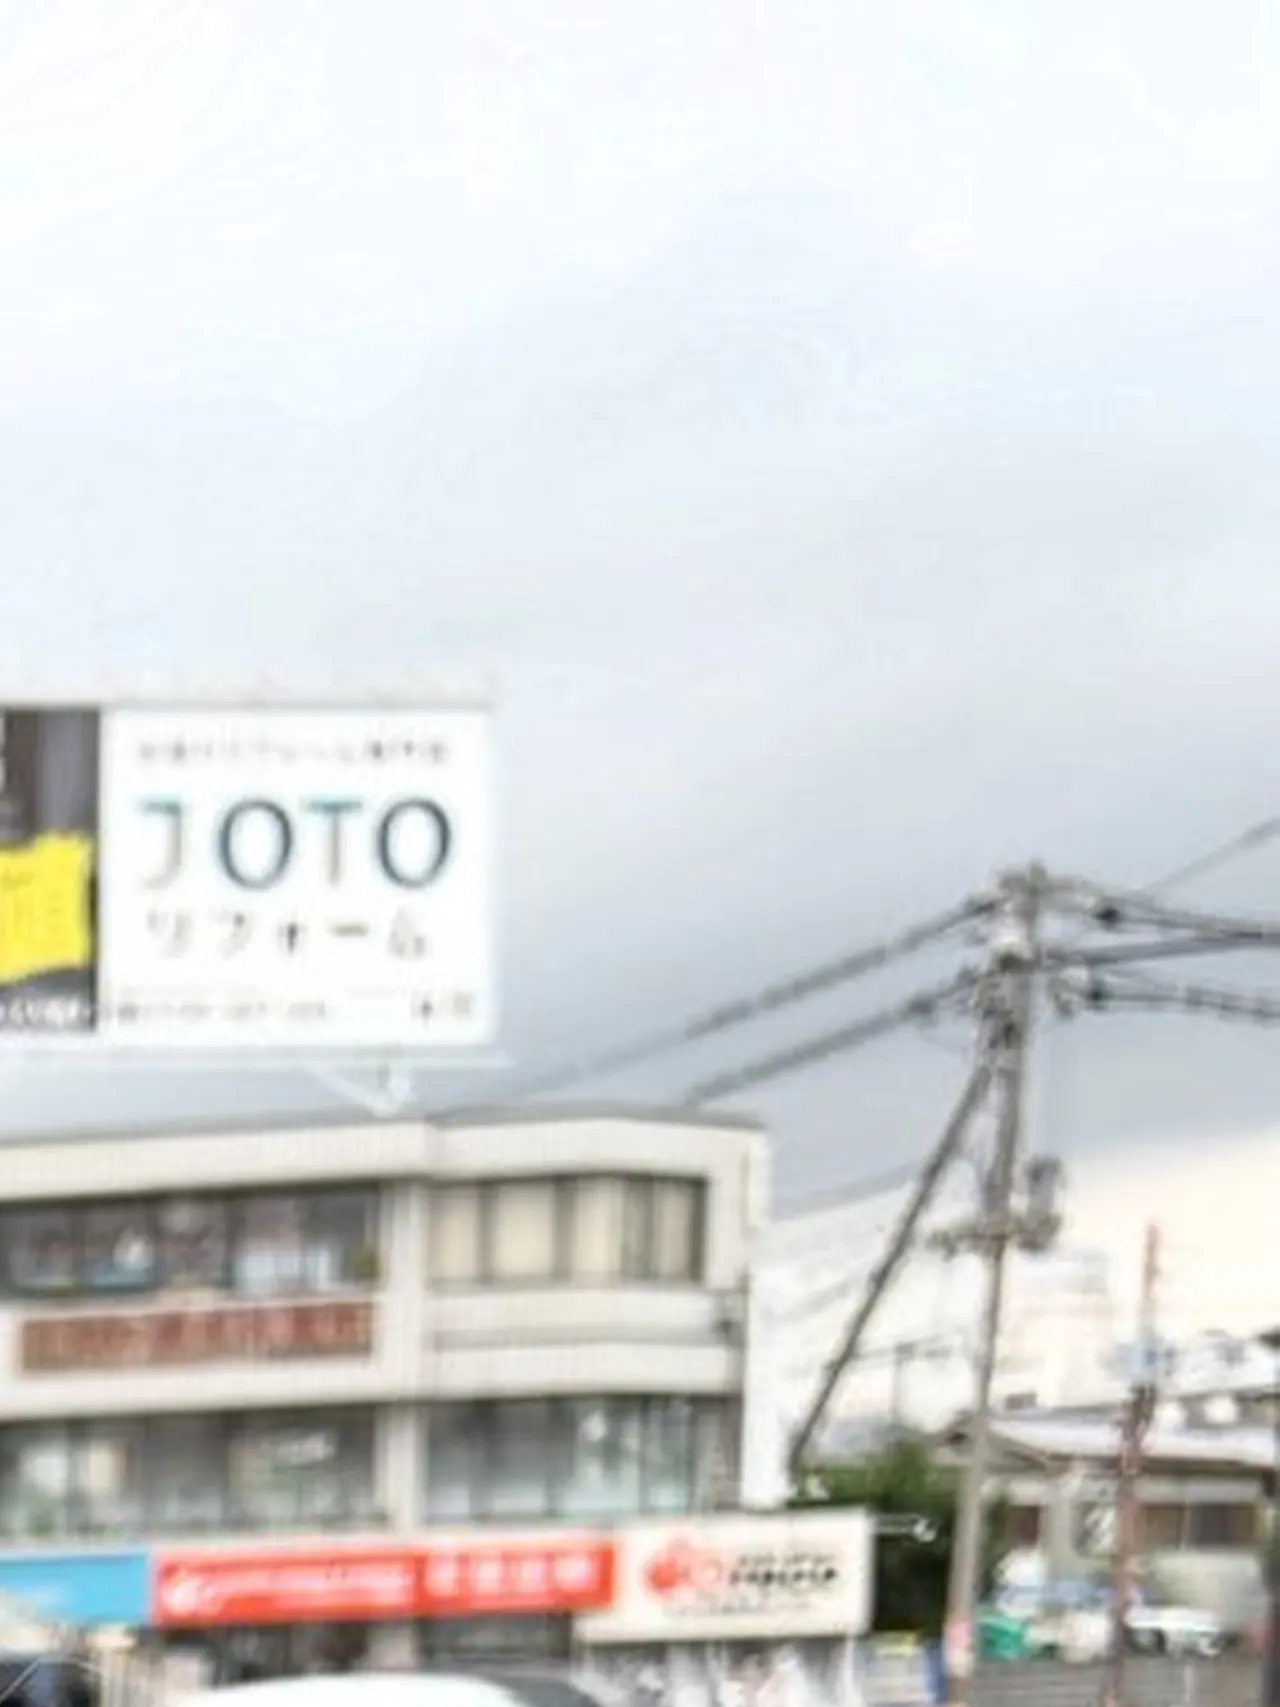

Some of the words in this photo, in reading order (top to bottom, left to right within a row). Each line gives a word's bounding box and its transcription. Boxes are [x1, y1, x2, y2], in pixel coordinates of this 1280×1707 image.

[138, 794, 454, 890] JOTO
[146, 905, 431, 960] リフォーム
